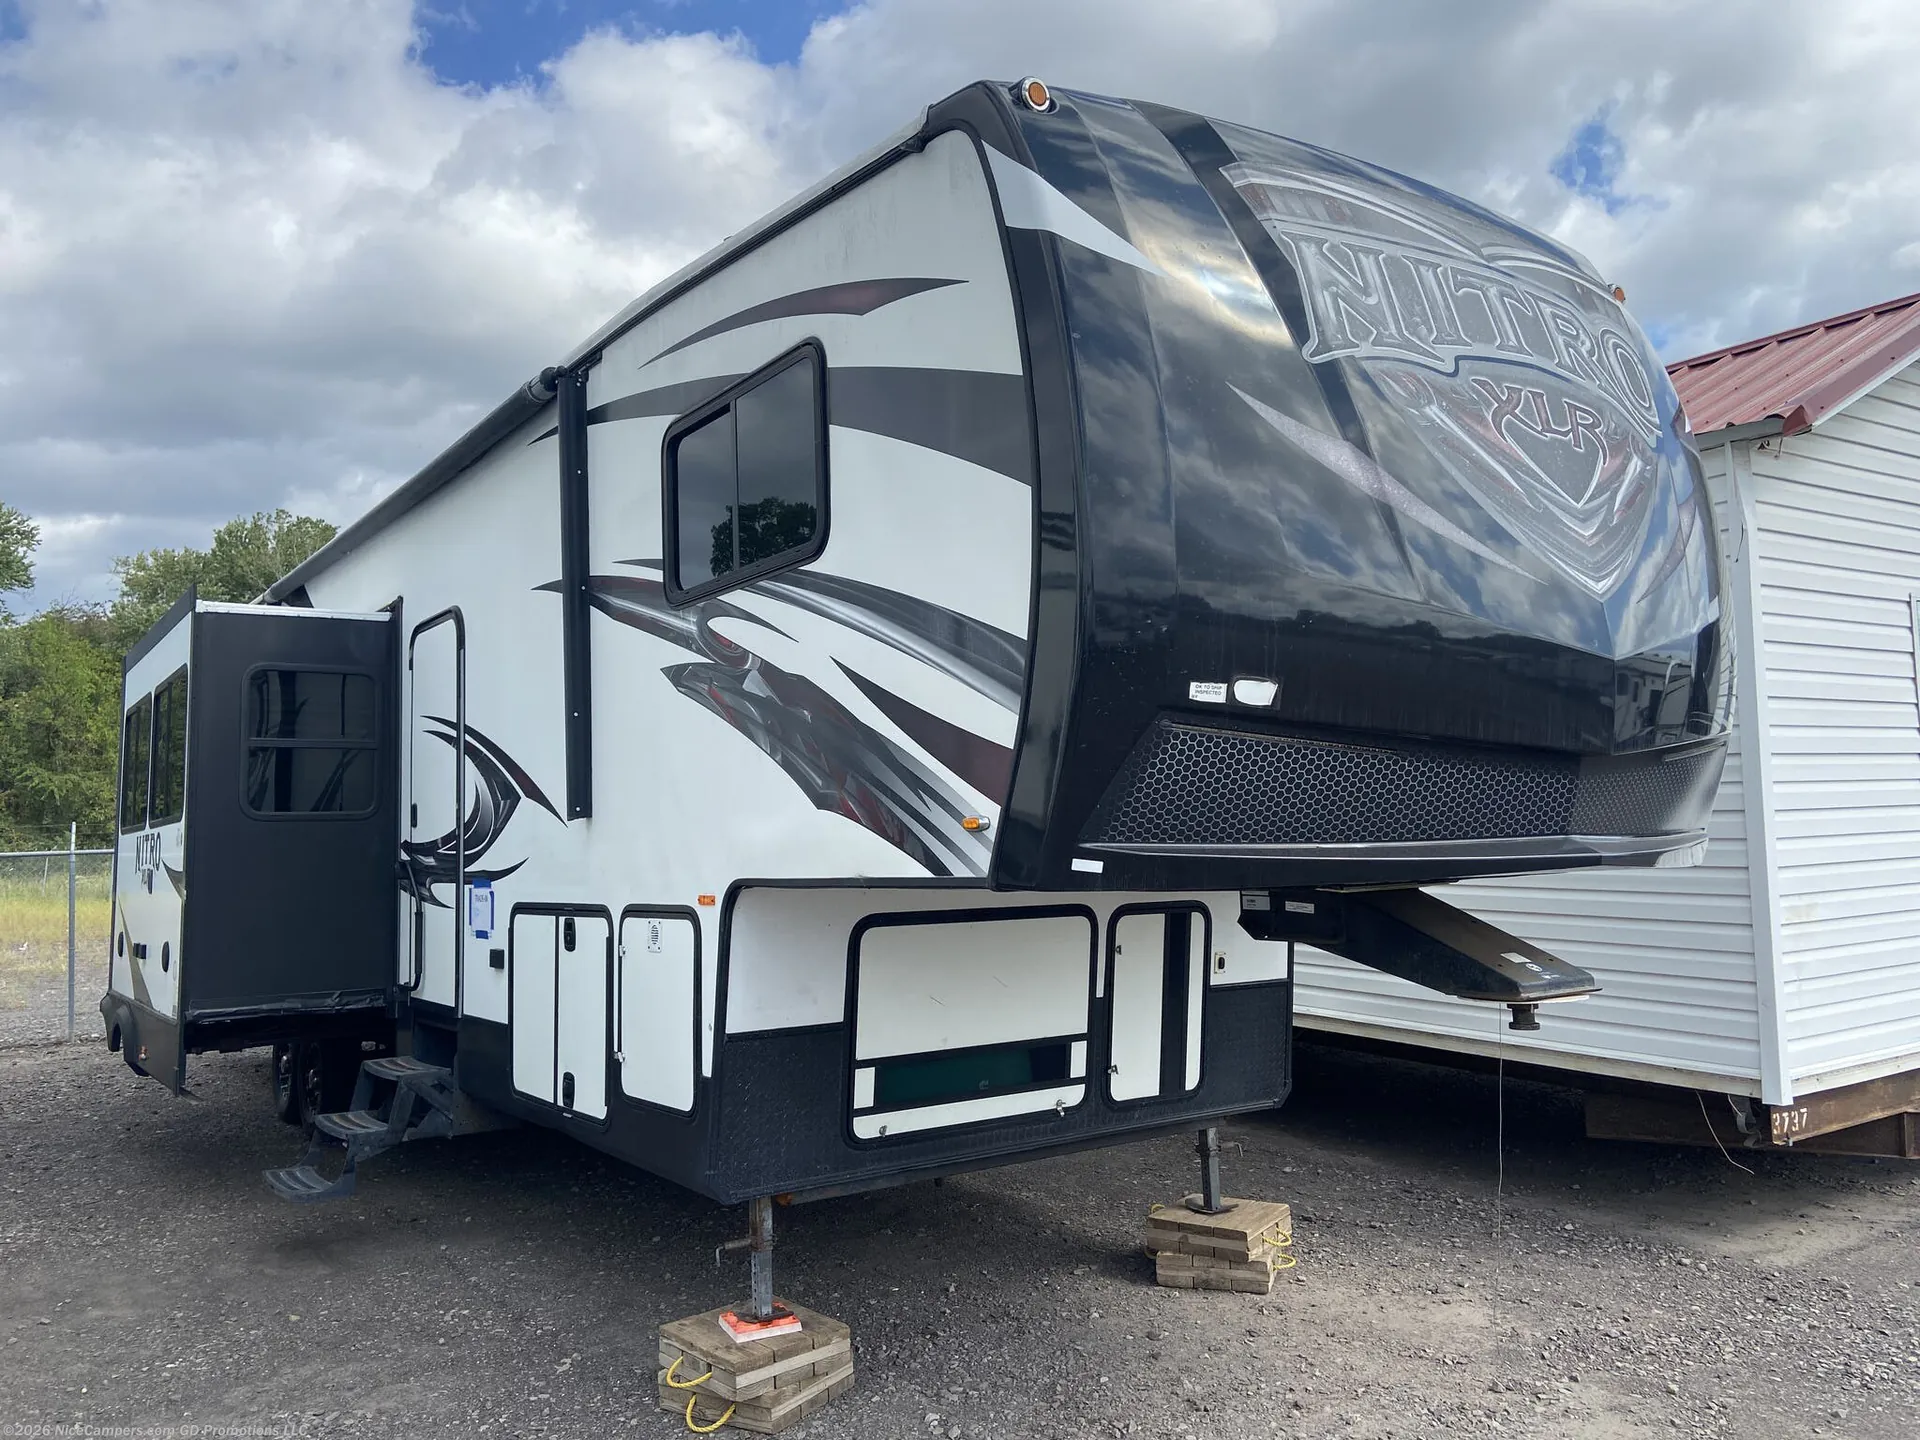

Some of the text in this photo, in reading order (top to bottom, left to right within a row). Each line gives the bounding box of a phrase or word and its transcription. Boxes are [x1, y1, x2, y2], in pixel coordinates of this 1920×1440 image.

[1281, 231, 1661, 436] NITRO
[1472, 378, 1609, 466] XLR
[135, 832, 161, 874] NITRO
[1773, 1108, 1807, 1135] 3737
